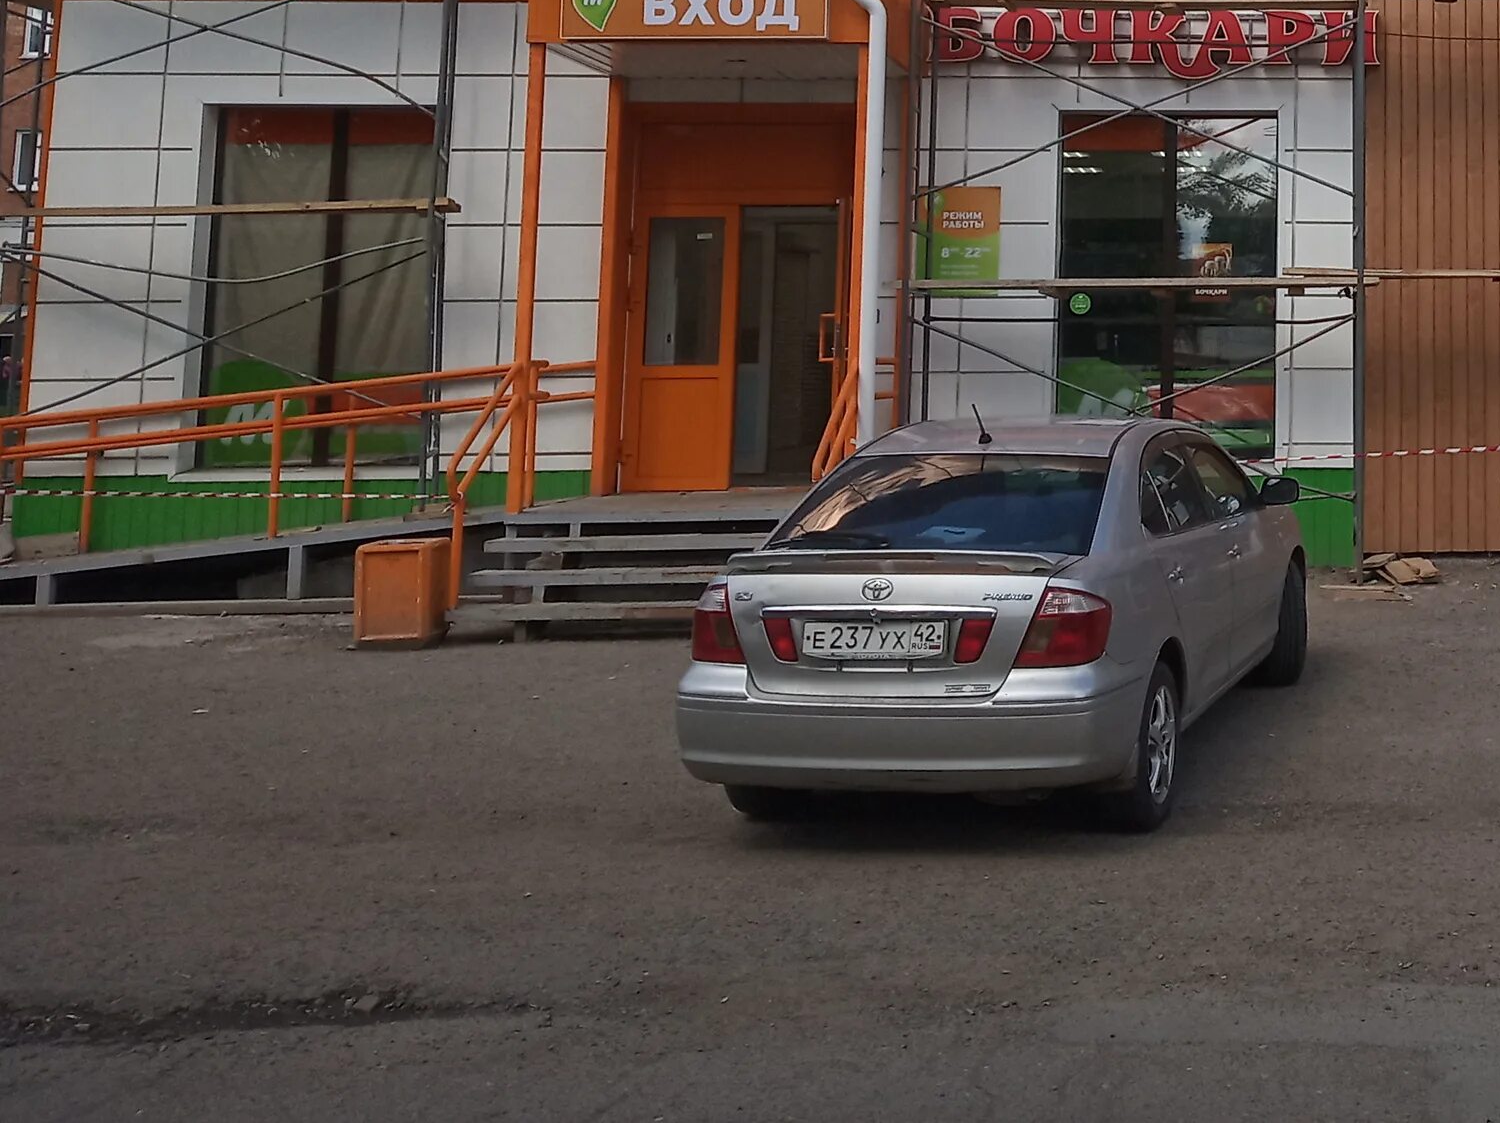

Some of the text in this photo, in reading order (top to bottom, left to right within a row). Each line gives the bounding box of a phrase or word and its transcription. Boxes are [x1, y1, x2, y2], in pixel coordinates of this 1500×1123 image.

[925, 6, 1380, 80] БОЧКАРИ
[943, 211, 982, 219] РЕЖИМ
[913, 624, 936, 642] 42
[911, 642, 929, 650] RUS
